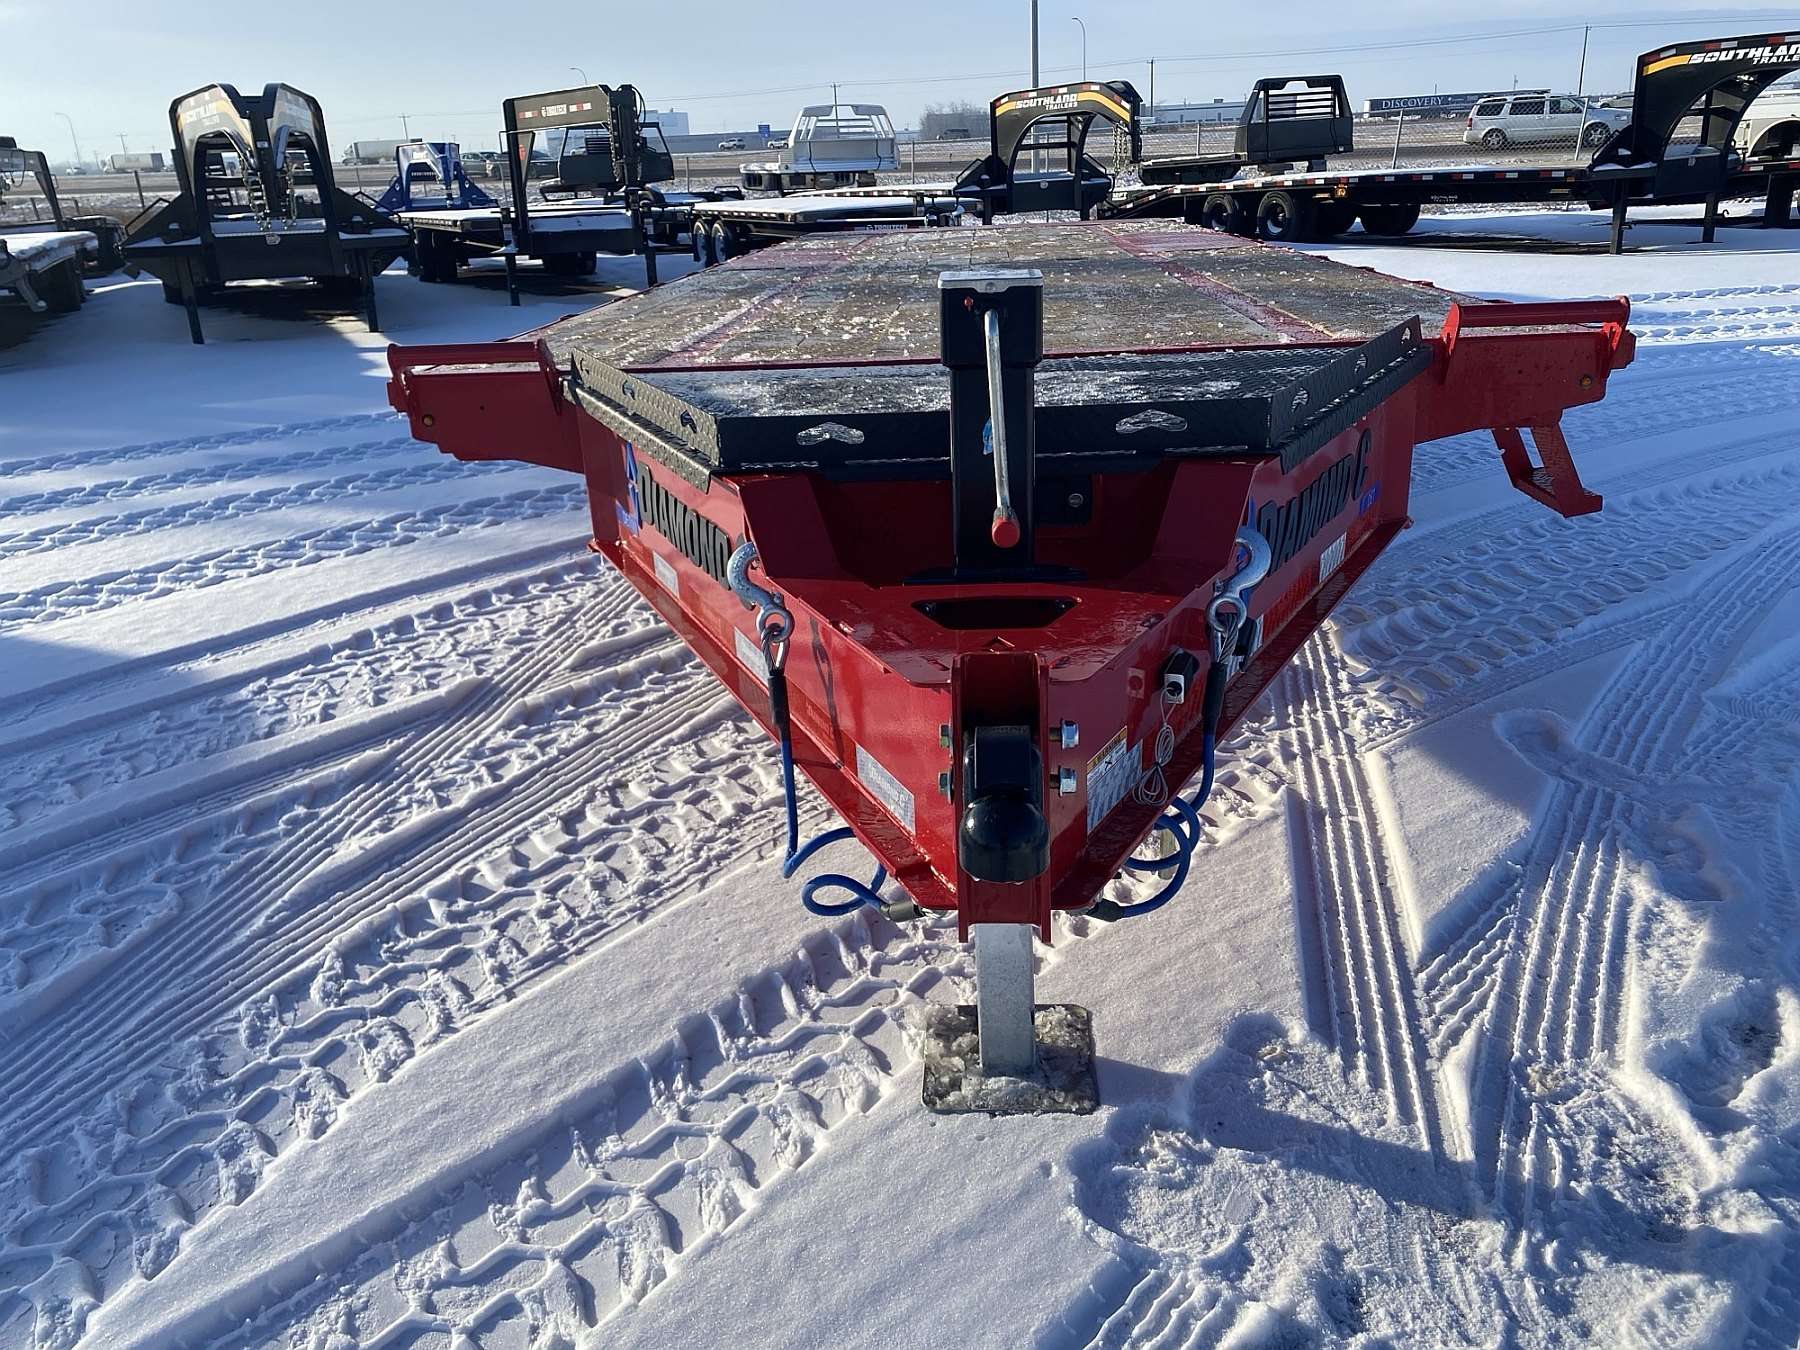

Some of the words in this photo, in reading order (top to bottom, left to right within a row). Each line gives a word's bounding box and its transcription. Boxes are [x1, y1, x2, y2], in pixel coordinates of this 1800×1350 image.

[1015, 93, 1078, 109] SOUTHLAND
[1046, 101, 1078, 111] TRAILERS
[1382, 97, 1443, 109] DISCOVERY
[1257, 453, 1354, 578] DIAMOND
[637, 460, 732, 591] DIAMOND
